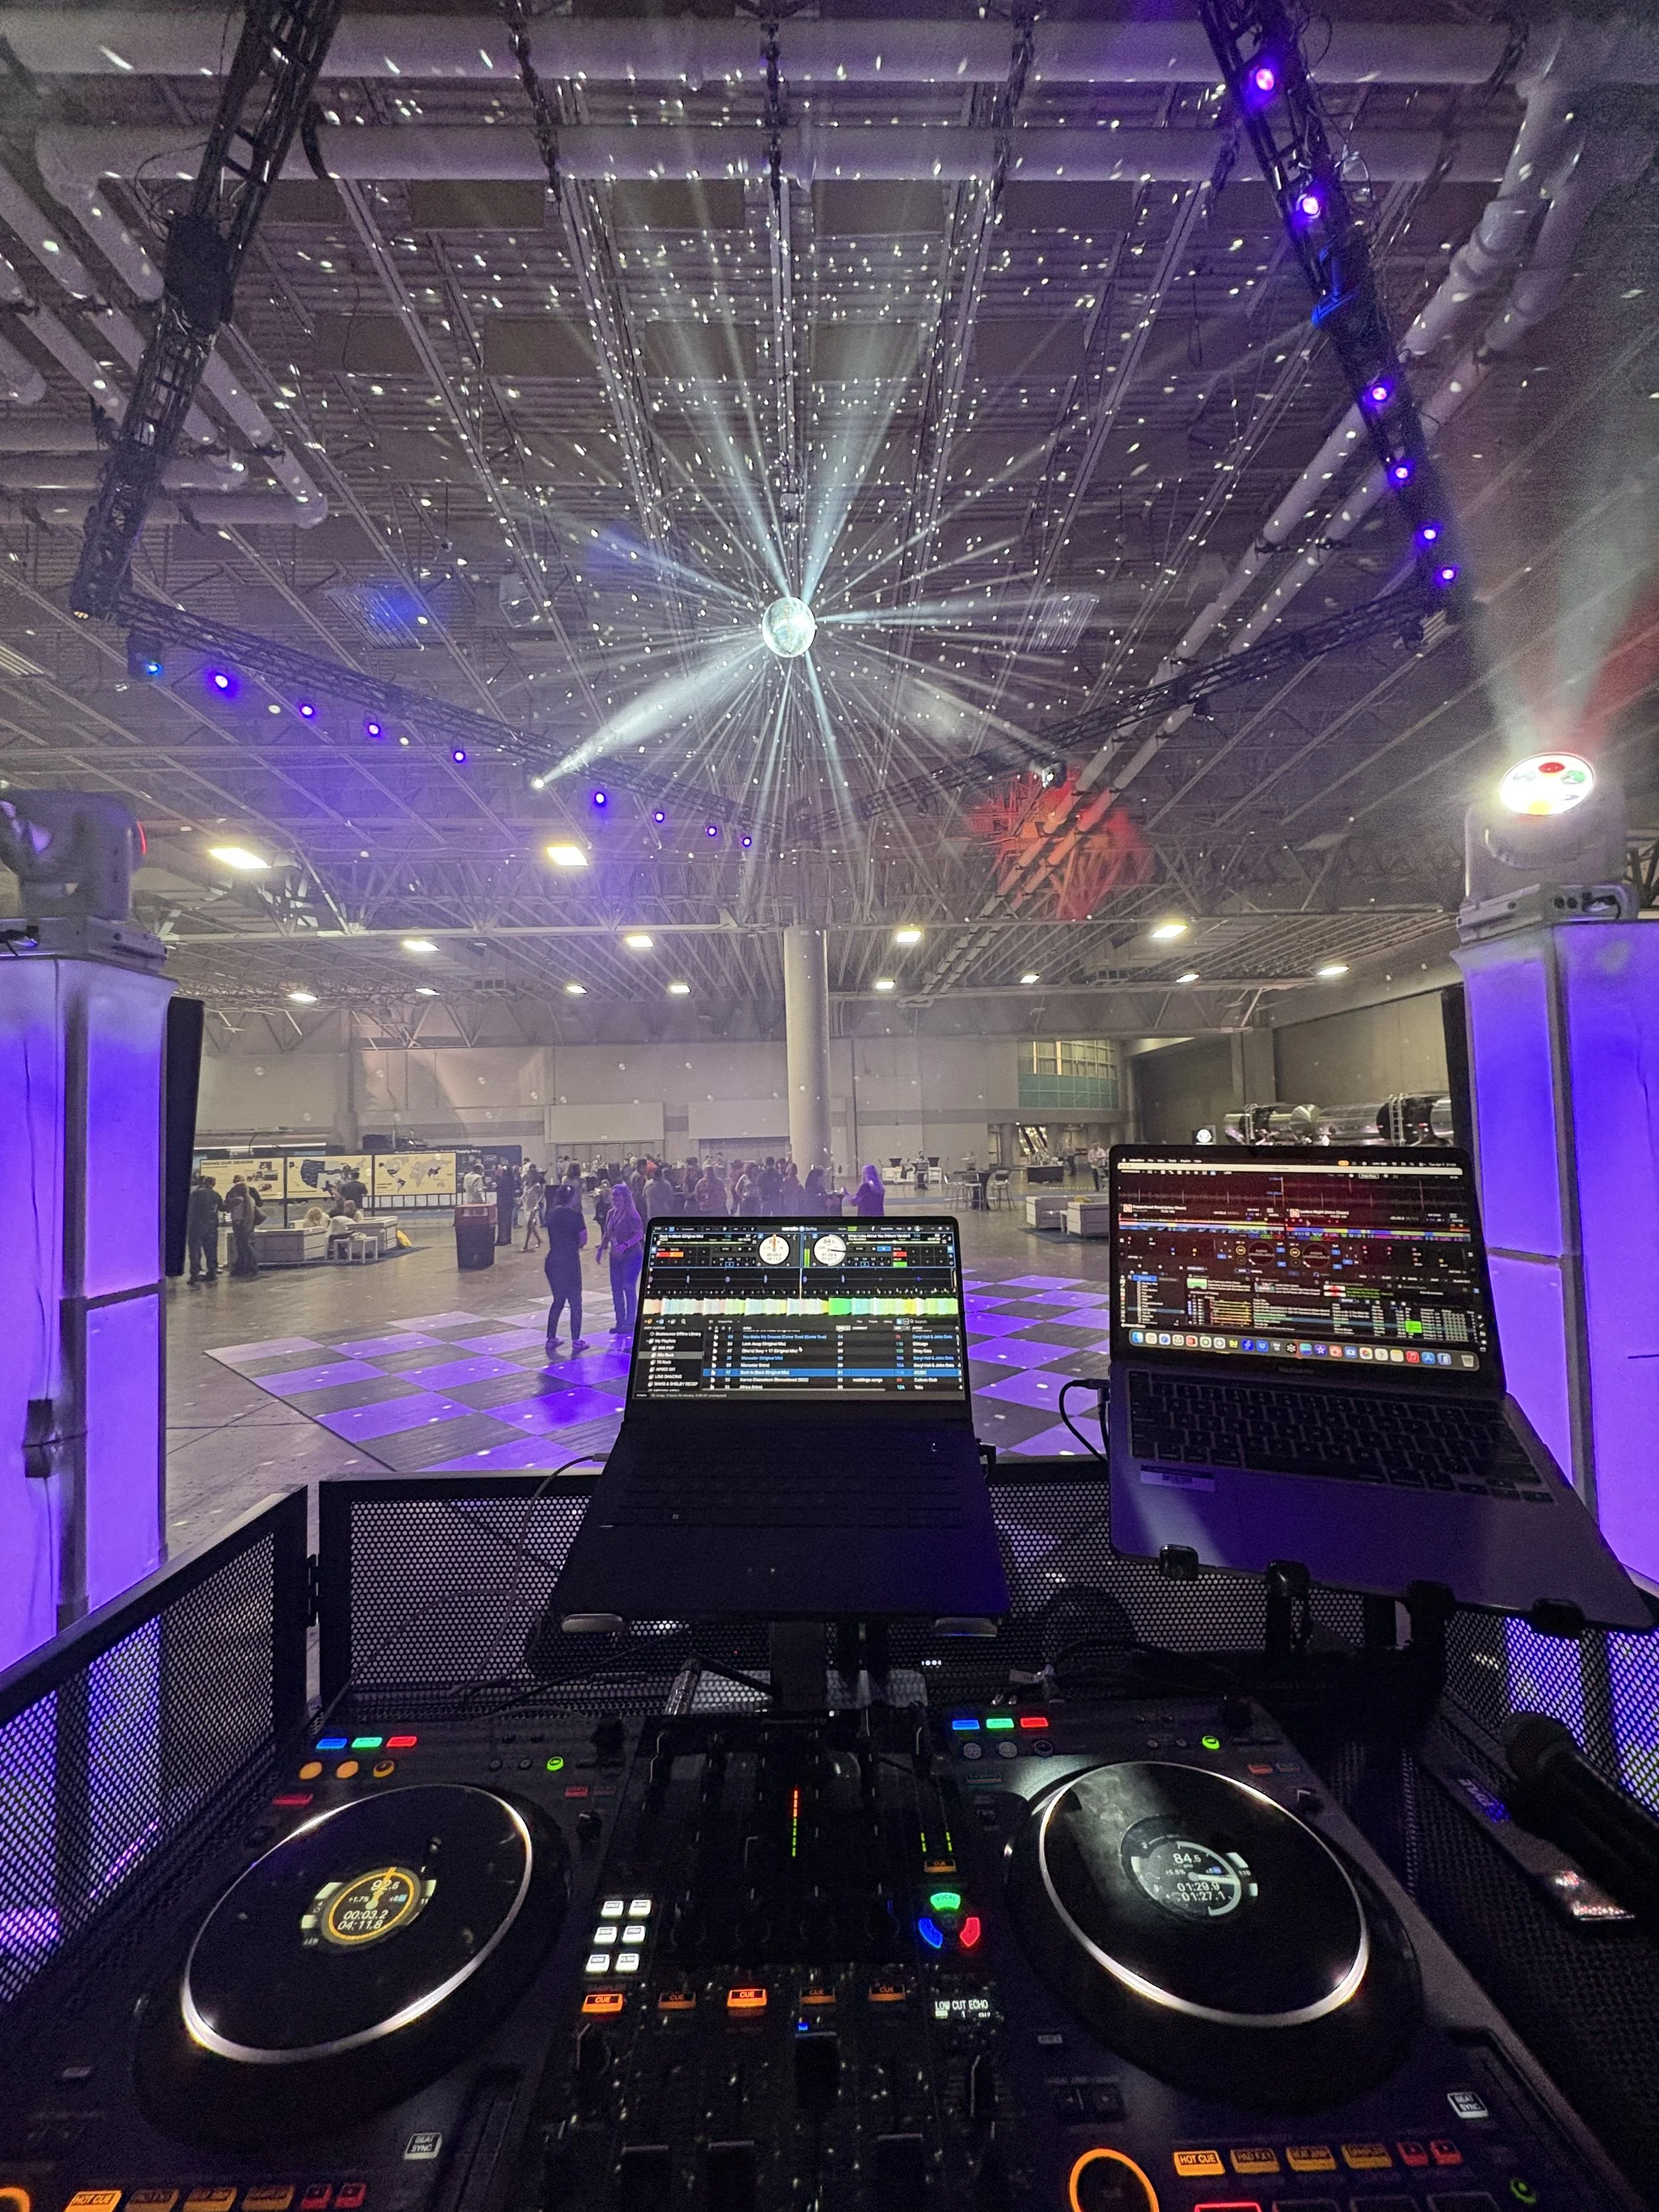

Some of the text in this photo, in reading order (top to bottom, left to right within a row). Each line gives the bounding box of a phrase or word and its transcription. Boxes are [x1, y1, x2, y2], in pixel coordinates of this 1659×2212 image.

[1173, 1853, 1201, 1864] 84.5
[1177, 1882, 1220, 1892] 01:29.9
[344, 1910, 389, 1920] 00:03.2
[338, 1920, 383, 1930] 04:11.8
[935, 1999, 988, 2010] LOW CUT ECHO
[1180, 2154, 1216, 2164] HOT CUE
[74, 2194, 111, 2204] HOT CUE
